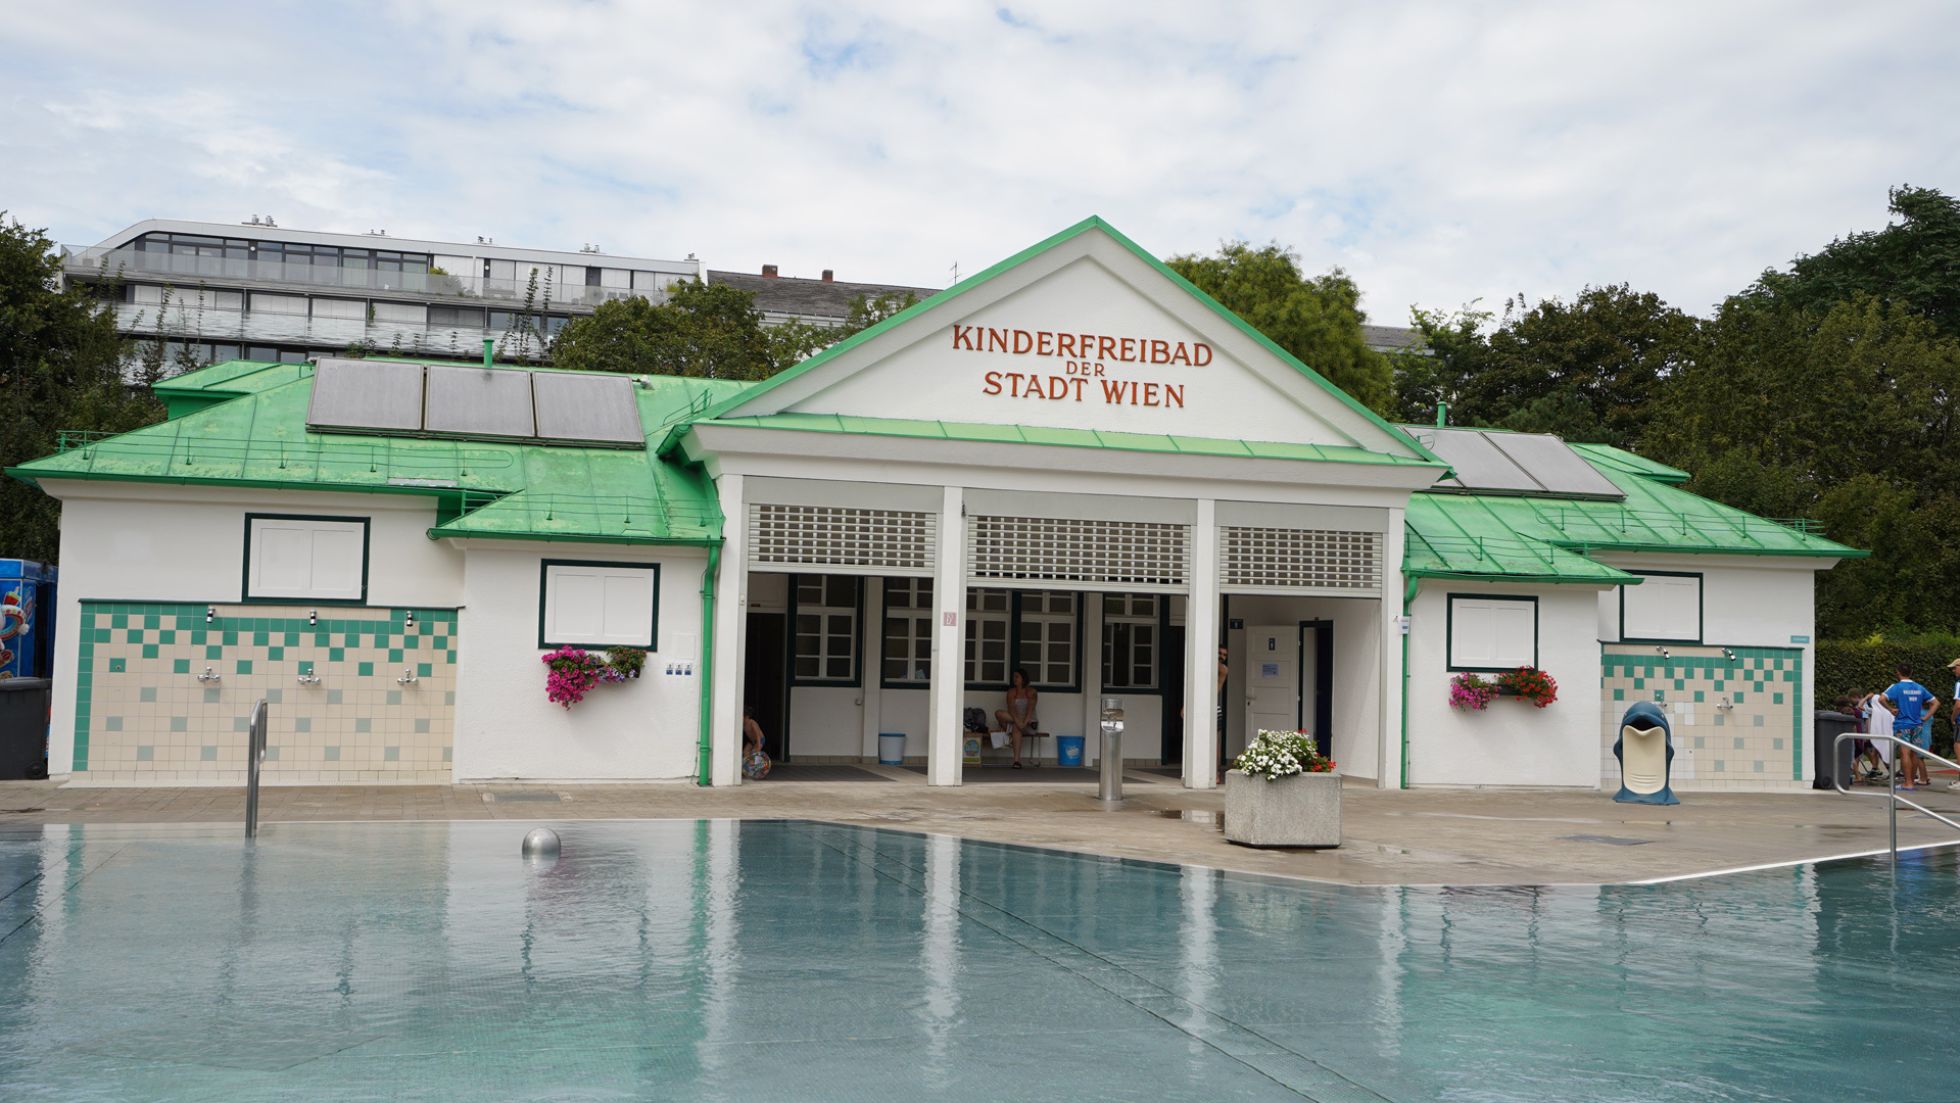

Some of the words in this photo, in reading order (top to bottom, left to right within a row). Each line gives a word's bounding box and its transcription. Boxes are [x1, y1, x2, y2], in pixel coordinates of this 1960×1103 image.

[953, 324, 1213, 367] KINDERFREIBAD
[1066, 361, 1105, 377] DER
[982, 371, 1089, 402] STADT
[1100, 379, 1185, 408] WIEN
